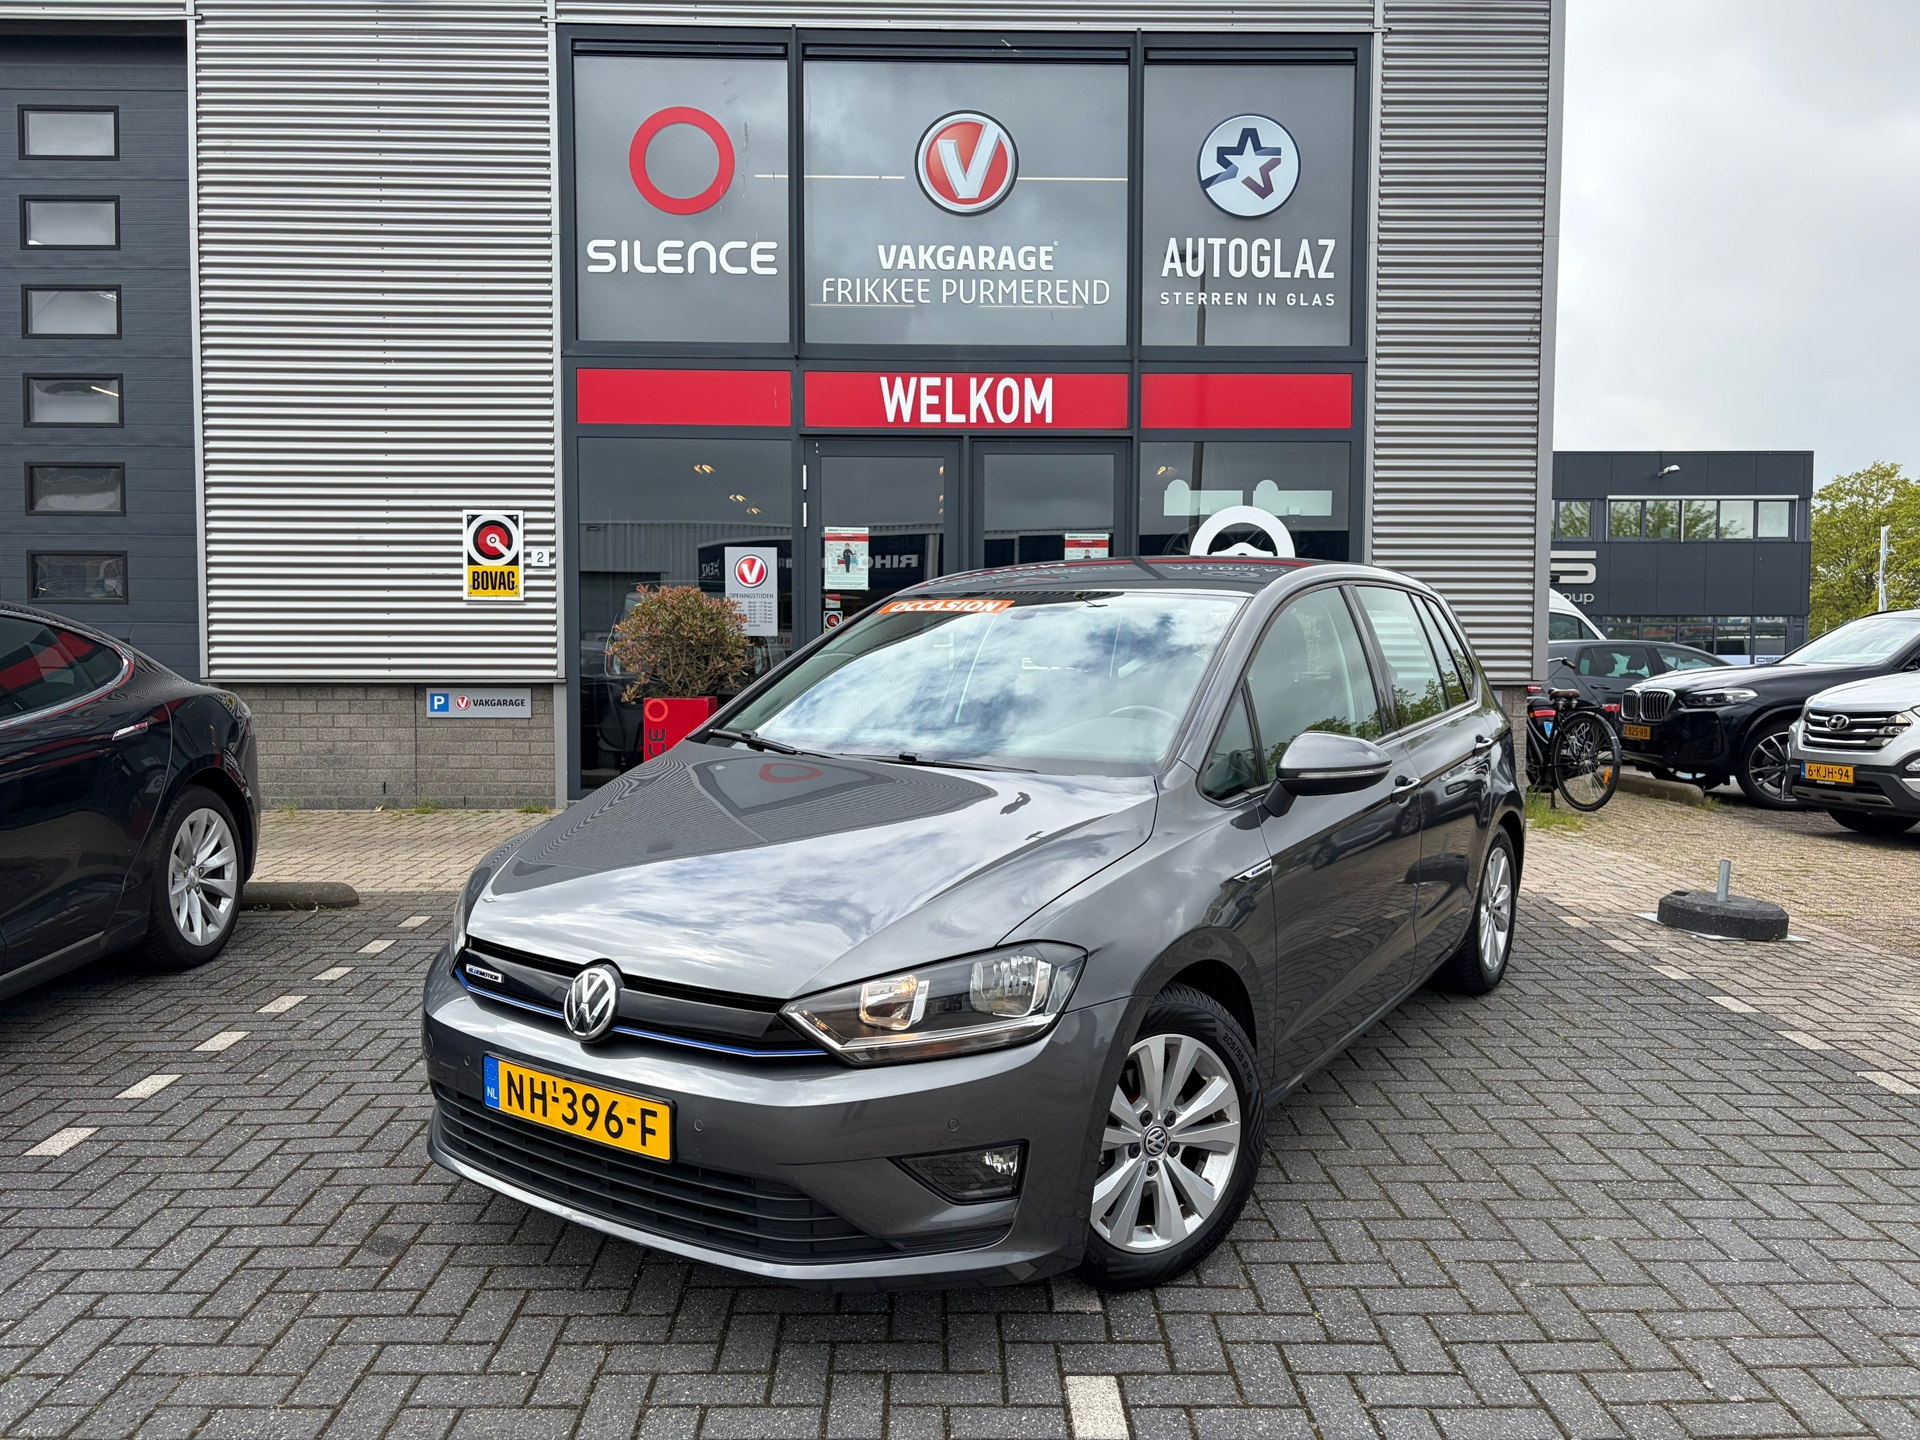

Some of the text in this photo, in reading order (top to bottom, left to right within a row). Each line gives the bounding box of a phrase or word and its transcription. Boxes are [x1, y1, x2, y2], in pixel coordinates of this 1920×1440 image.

[586, 239, 778, 275] SILENCE
[877, 244, 1054, 271] VAKGARAGE
[1161, 237, 1336, 279] AUTOGLAZ
[822, 278, 1111, 306] FRIKKEE PURMEREND
[1160, 291, 1335, 307] STERREN IN GLAS
[880, 376, 1054, 425] WELKOM
[536, 551, 544, 563] 2
[472, 570, 515, 591] BOVAG
[433, 695, 445, 710] P
[472, 699, 525, 707] VAKGARAGE
[1807, 764, 1851, 781] 6-KJH-94
[1222, 1032, 1245, 1062] 205/55
[1245, 1069, 1254, 1083] 16
[486, 1069, 658, 1147] NL NH-396-F
